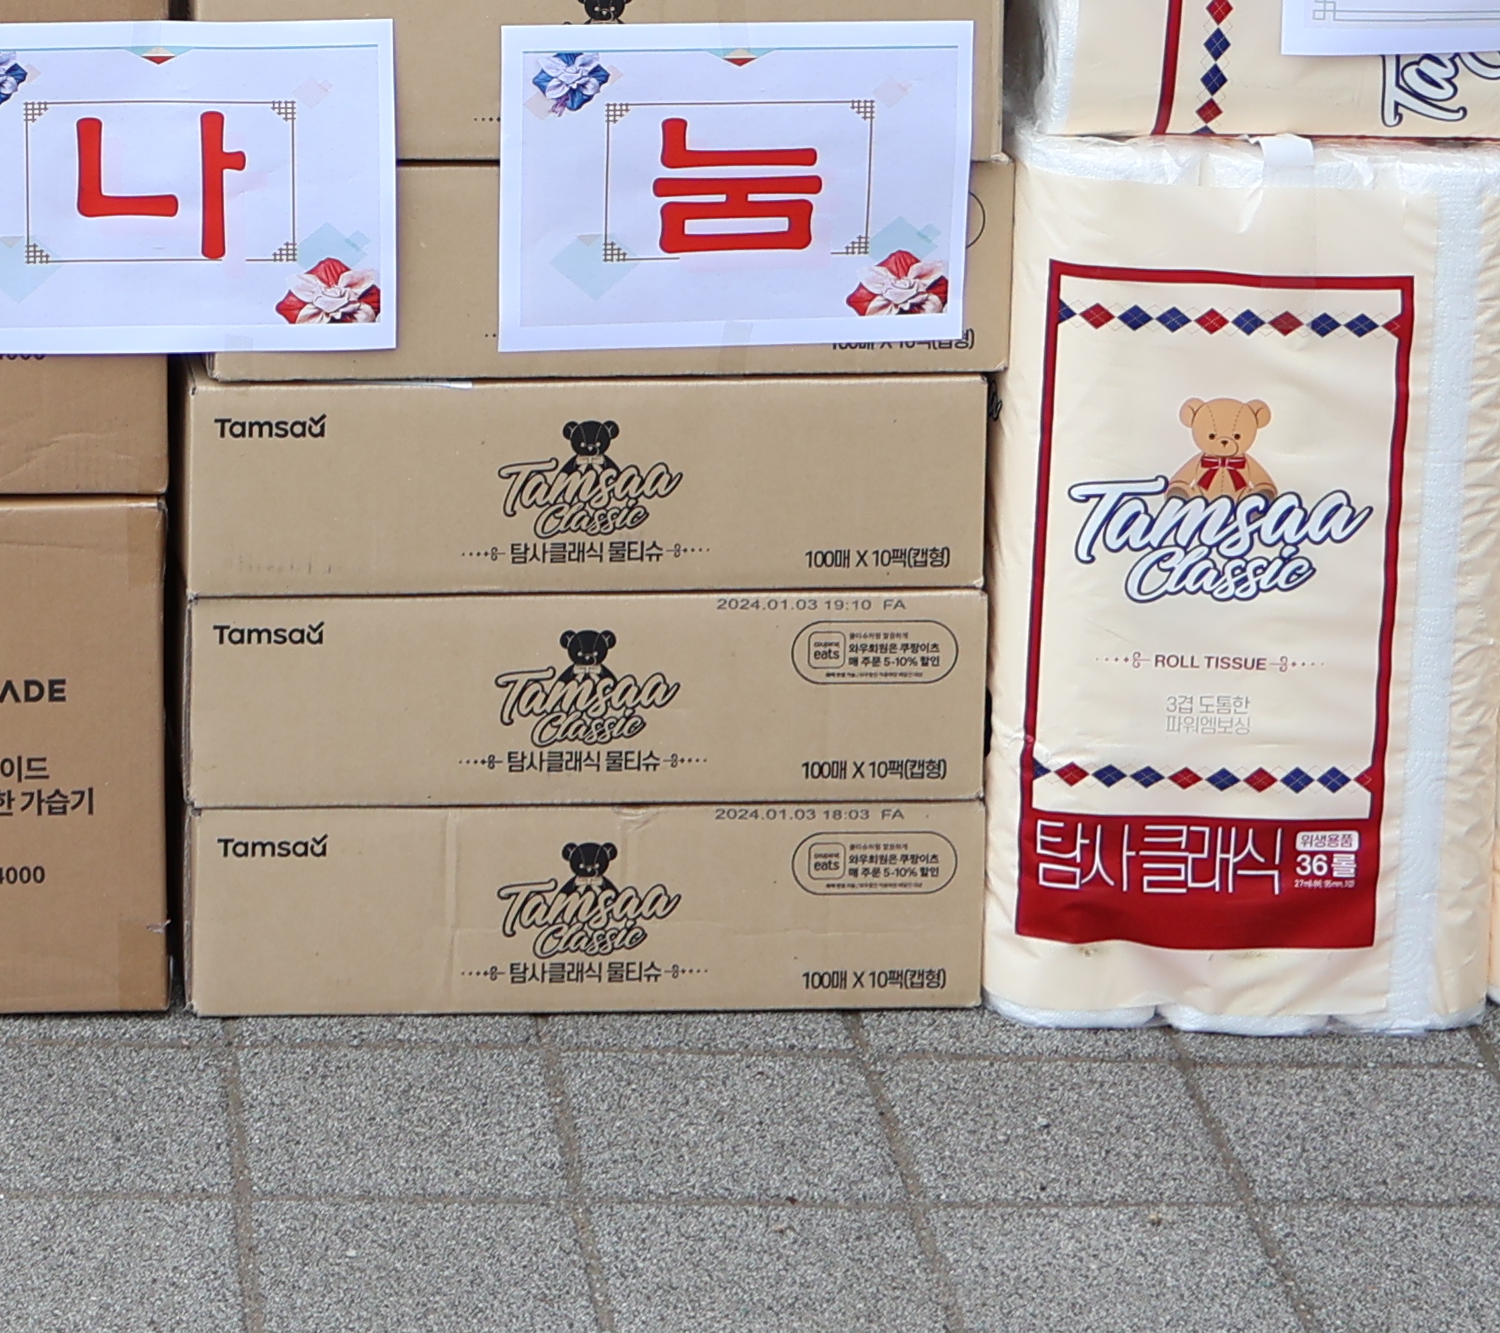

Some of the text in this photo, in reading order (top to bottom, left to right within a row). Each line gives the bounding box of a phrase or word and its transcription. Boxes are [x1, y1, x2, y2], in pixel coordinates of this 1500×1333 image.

[76, 111, 246, 260] 나
[652, 118, 822, 254] 눔
[499, 459, 683, 517] Tamsaa
[534, 503, 649, 538] Classic
[1068, 475, 1373, 564] Tamsaa
[510, 542, 663, 565] 탐사클래식 물티슈
[806, 547, 950, 571] 100매 X 10팩(캡형)
[1125, 546, 1317, 603] Classic
[717, 598, 906, 612] 2024.01.03 19:10 FA
[814, 648, 840, 660] eats
[849, 643, 940, 654] 와우회원은 쿠팡이츠
[861, 657, 883, 667] 주문
[884, 657, 917, 667] 5-10%
[920, 657, 940, 666] 할인
[1154, 654, 1267, 672] ROLL TISSUE
[495, 668, 680, 725] Tamsaa
[1166, 694, 1251, 715] 3겹 도톰한
[531, 713, 647, 747] Classic
[1166, 715, 1251, 735] 파워엠보싱
[507, 751, 661, 775] 탐사클래식 물티슈
[802, 758, 946, 782] 100매 10팩(캡형)
[20, 789, 94, 817] 가습기
[715, 808, 904, 822] 2024.01.03 18:03 FA
[1299, 834, 1354, 849] 위생용품
[498, 880, 682, 939] Tamsaa
[533, 924, 647, 958] Classic
[510, 961, 663, 985] 탐사클래식 물티슈
[802, 967, 946, 991] 100매 10팩(캡형)
